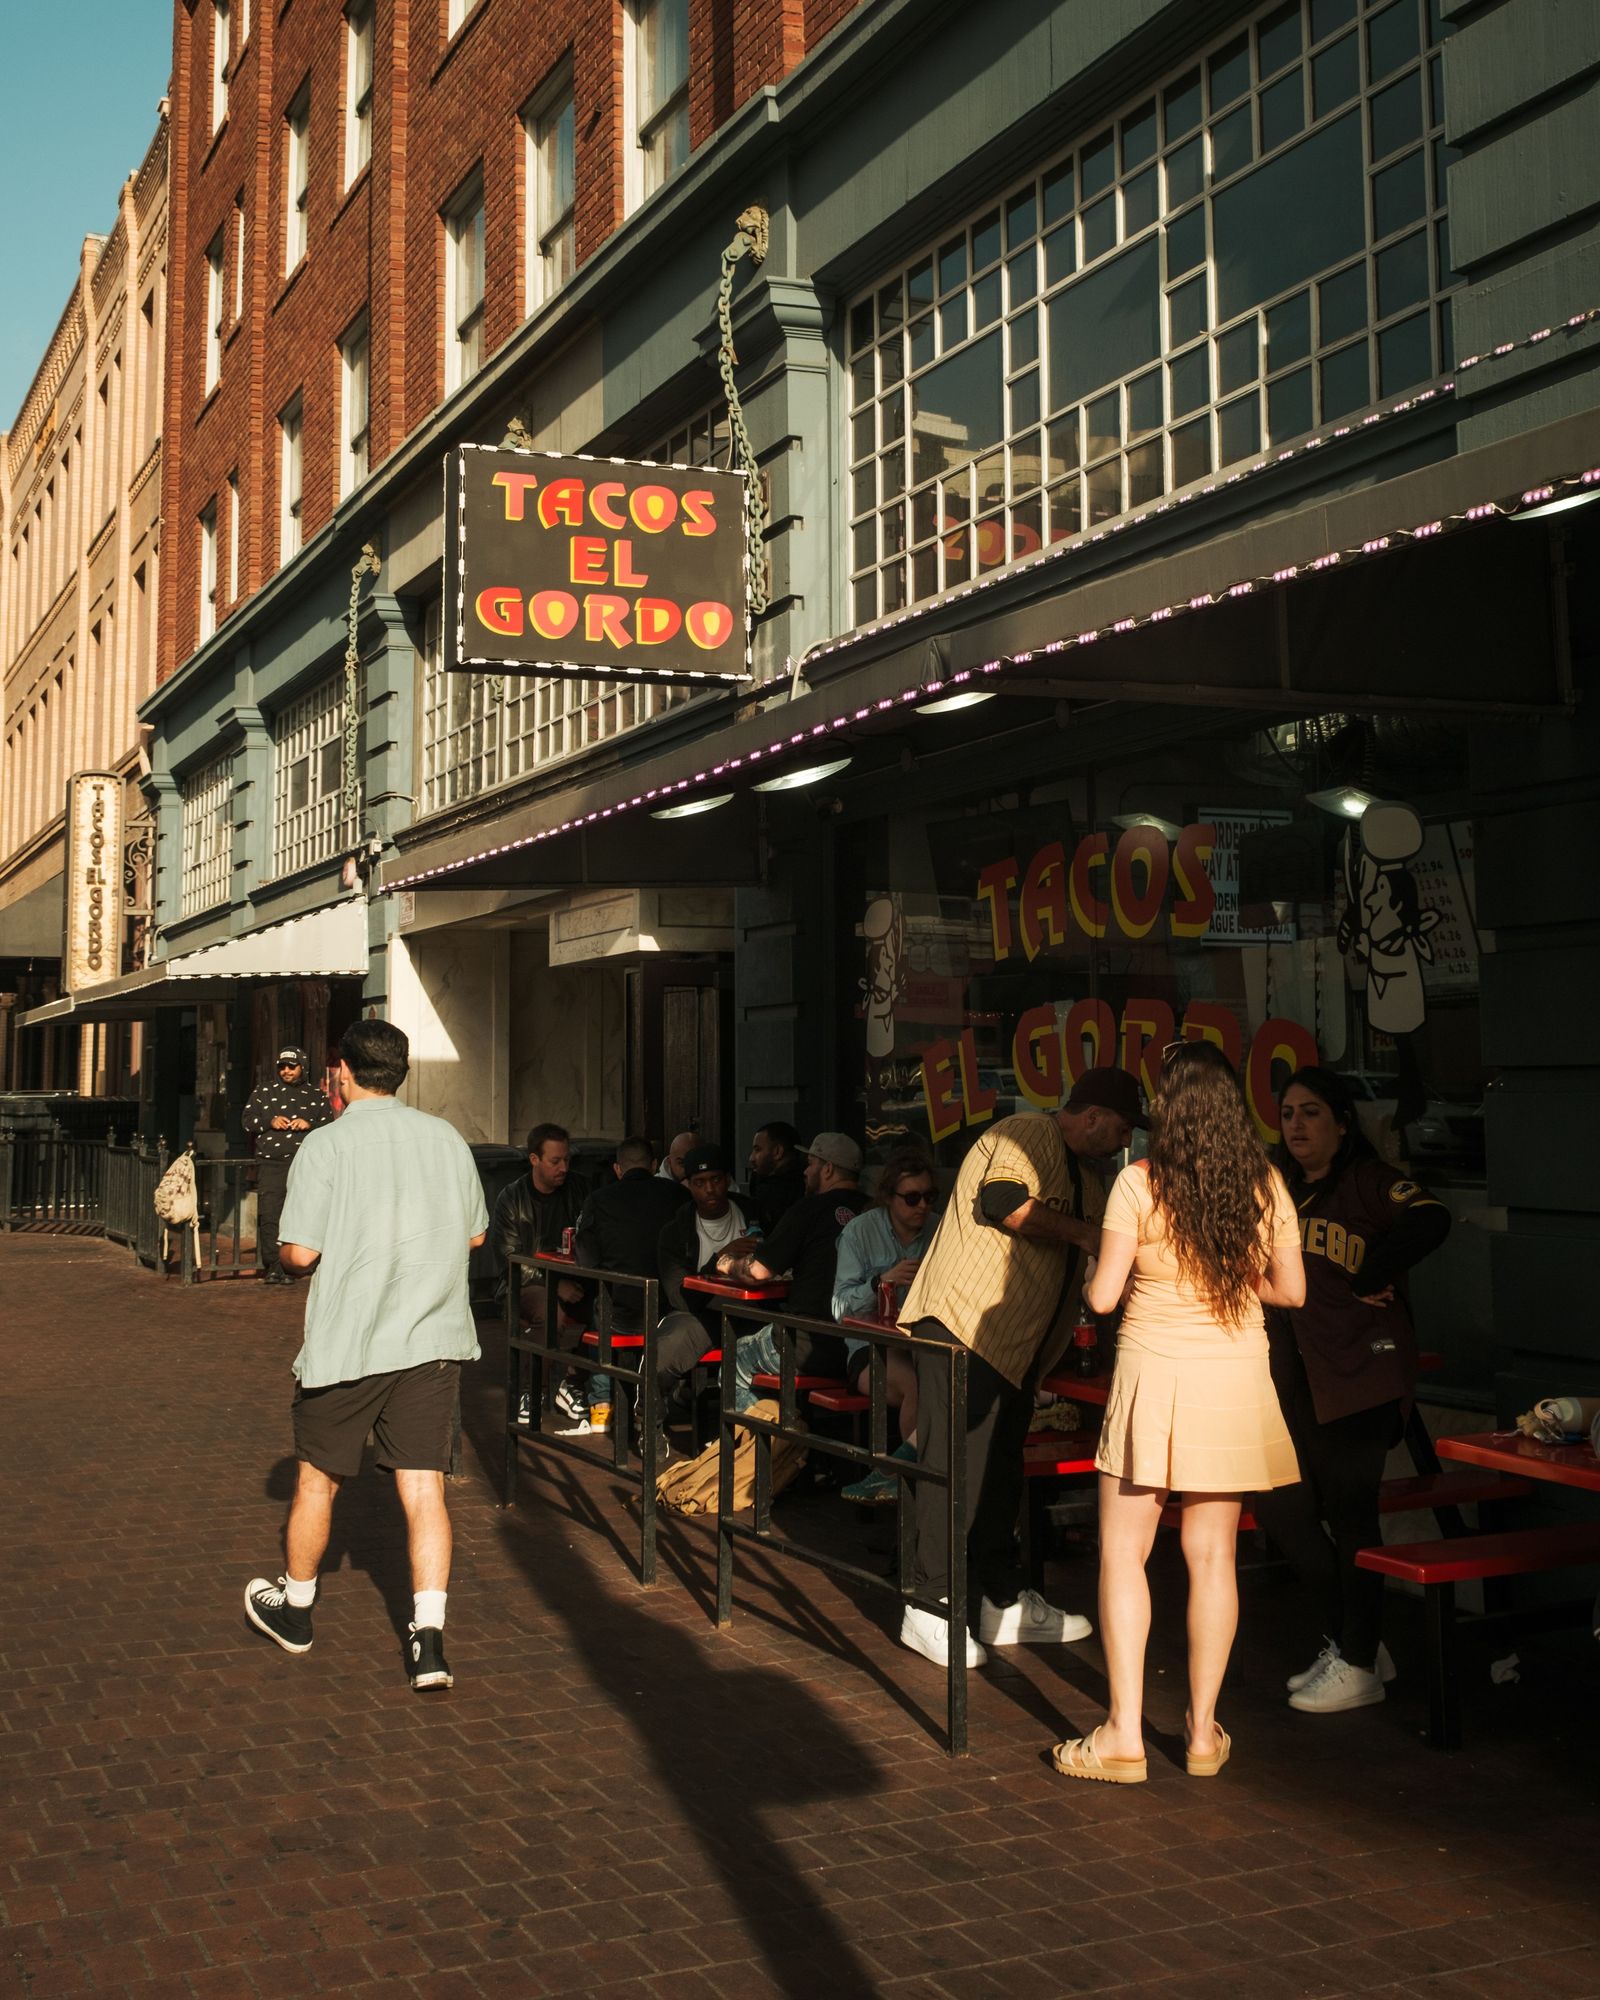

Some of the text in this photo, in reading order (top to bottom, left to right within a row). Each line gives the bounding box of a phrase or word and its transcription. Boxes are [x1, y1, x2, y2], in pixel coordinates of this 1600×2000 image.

[491, 471, 718, 537] TACOS
[569, 535, 649, 588] EL
[475, 586, 734, 650] GORDO
[86, 783, 107, 972] TACOS EL GORDO
[976, 823, 1218, 963] TACOS
[1209, 913, 1235, 934] AGUE
[920, 1026, 997, 1145] EL
[1299, 1217, 1368, 1275] IEGO
